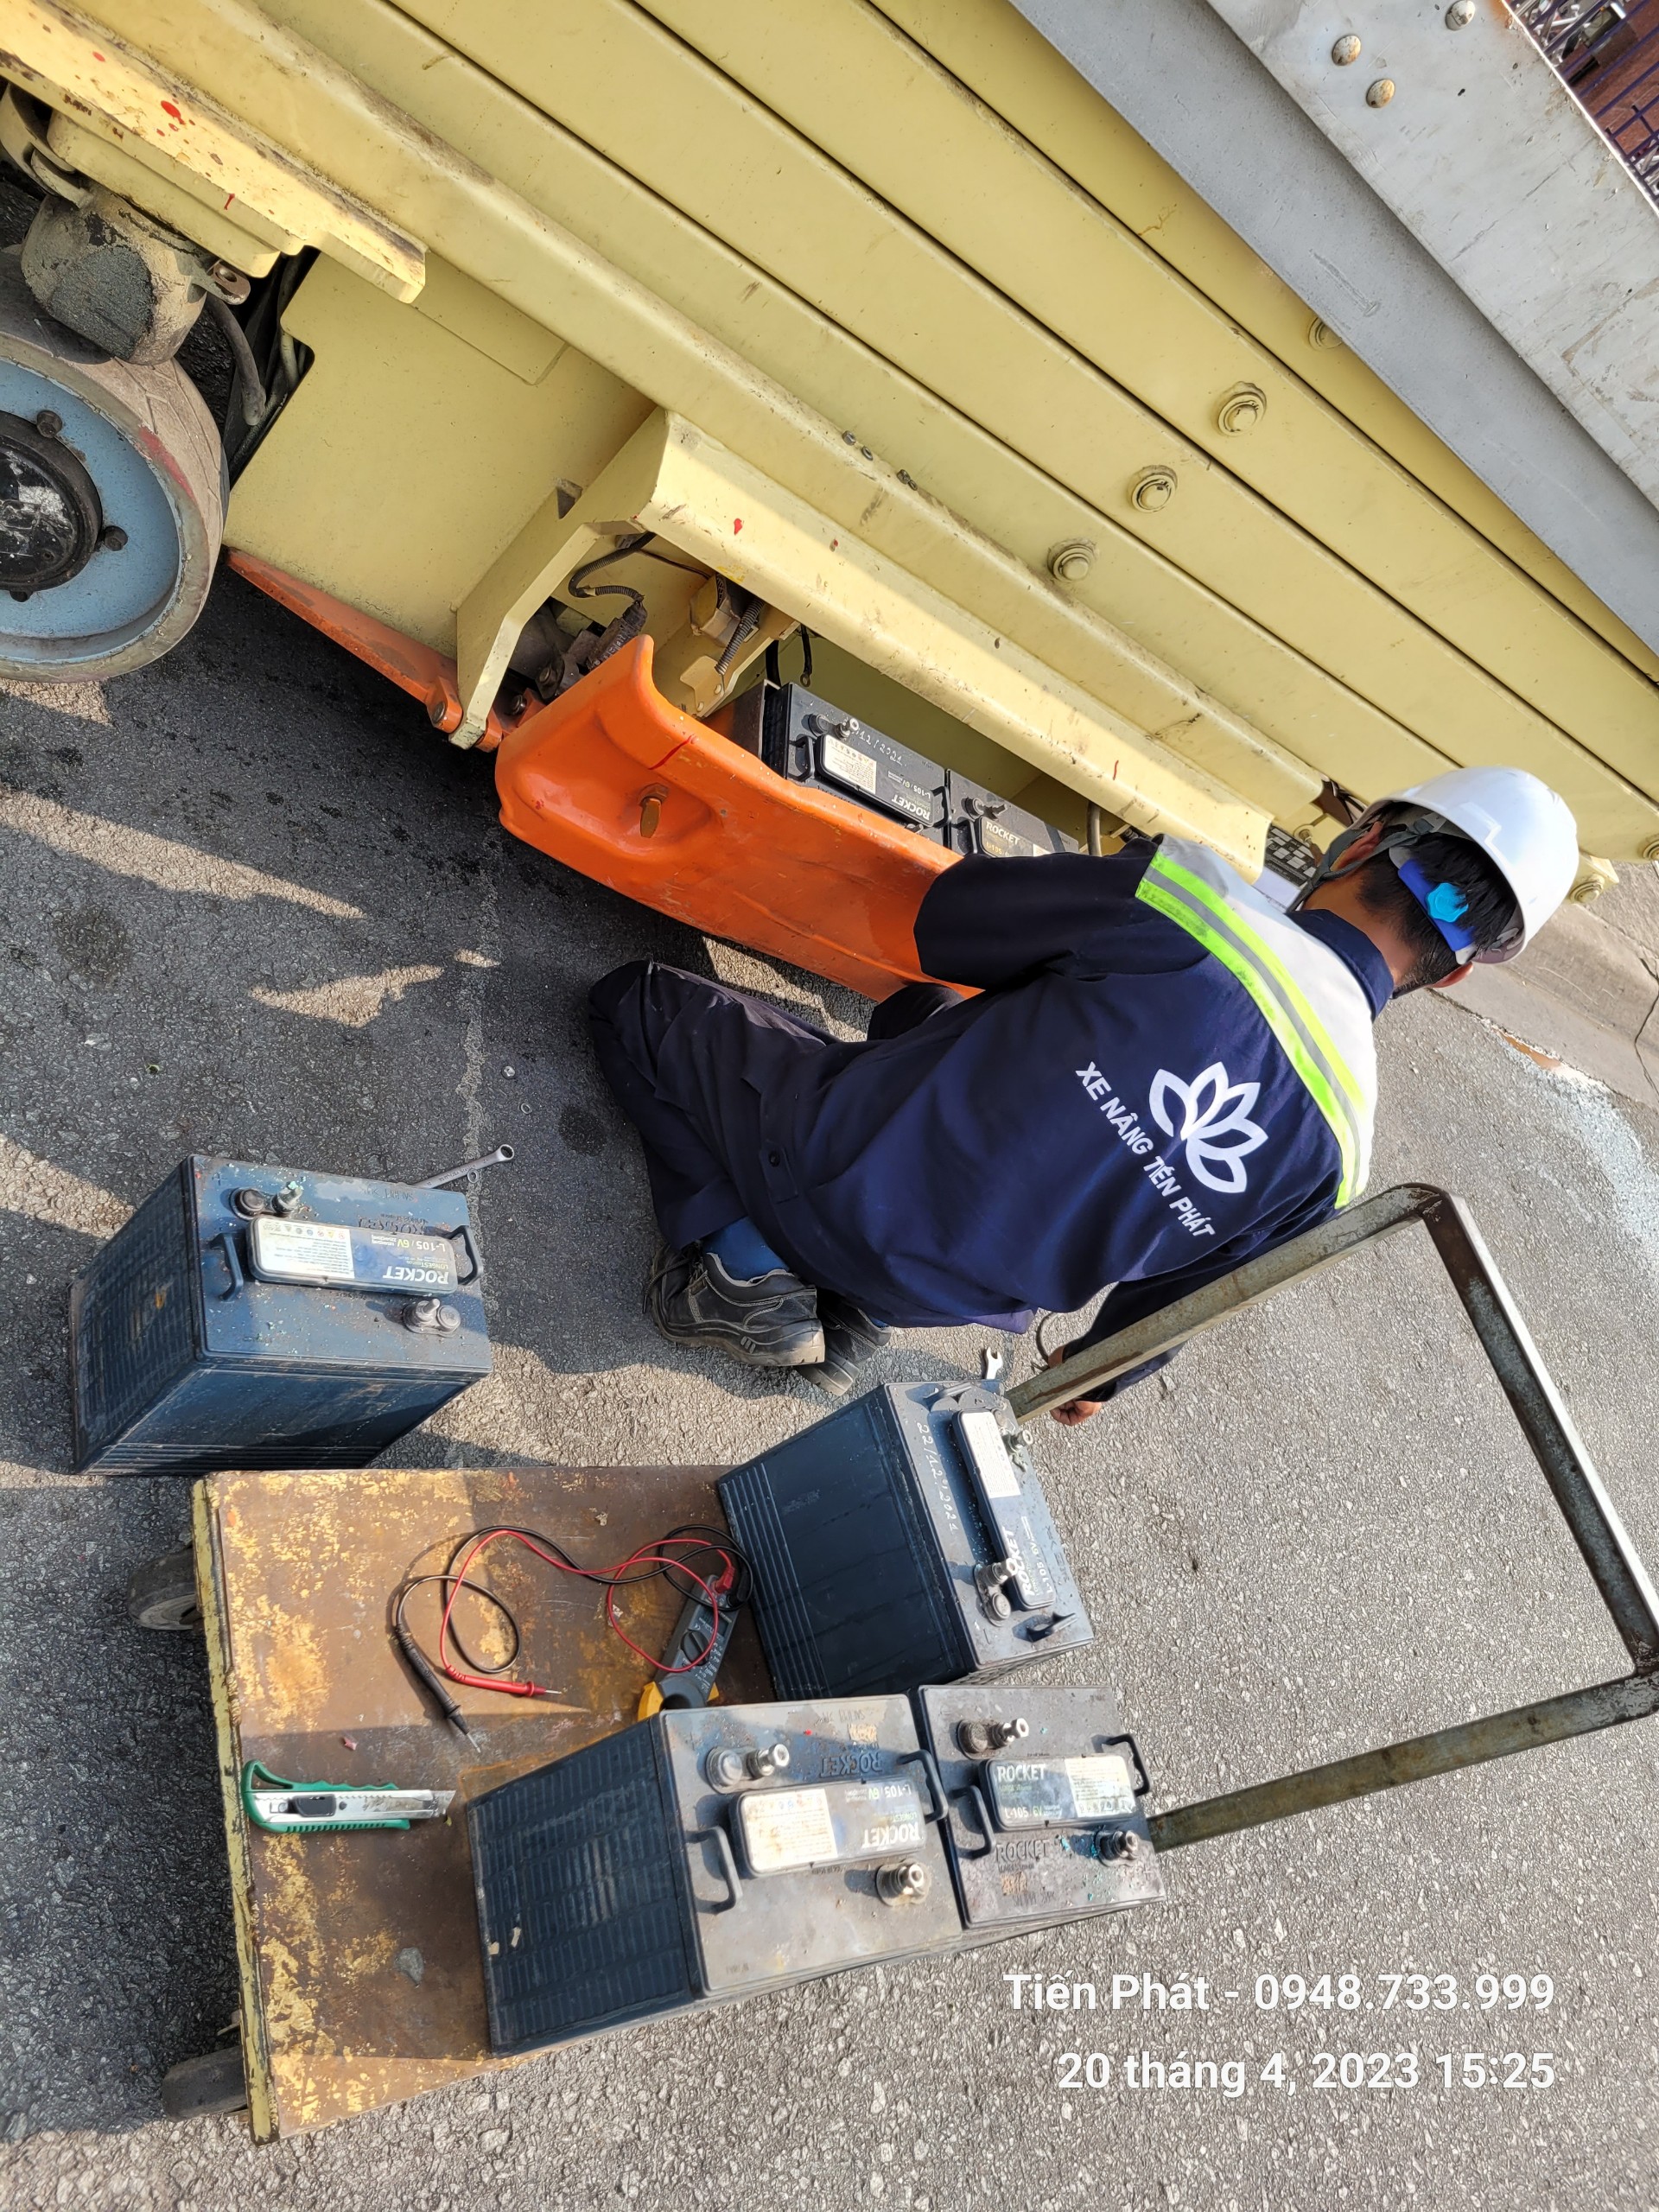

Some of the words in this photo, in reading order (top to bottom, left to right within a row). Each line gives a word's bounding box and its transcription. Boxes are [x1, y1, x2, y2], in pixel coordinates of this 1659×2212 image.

[891, 794, 931, 821] ROCKET
[986, 821, 1020, 845] ROCKET
[1076, 1061, 1111, 1101] XE
[1100, 1097, 1154, 1154] NÂNG
[1169, 1196, 1216, 1236] PHÁT
[397, 1238, 410, 1249] 6V
[416, 1240, 446, 1252] L-105
[383, 1265, 449, 1285] ROCKET
[1002, 1526, 1035, 1595] ROCKET
[1037, 1561, 1053, 1593] L-105
[819, 1751, 883, 1778] ROCKET
[996, 1764, 1046, 1783] ROCKET
[868, 1787, 880, 1800] 6V
[884, 1783, 912, 1798] L-105
[1004, 1807, 1028, 1818] L-105
[861, 1822, 921, 1849] ROCKET
[995, 1840, 1050, 1864] ROCKET
